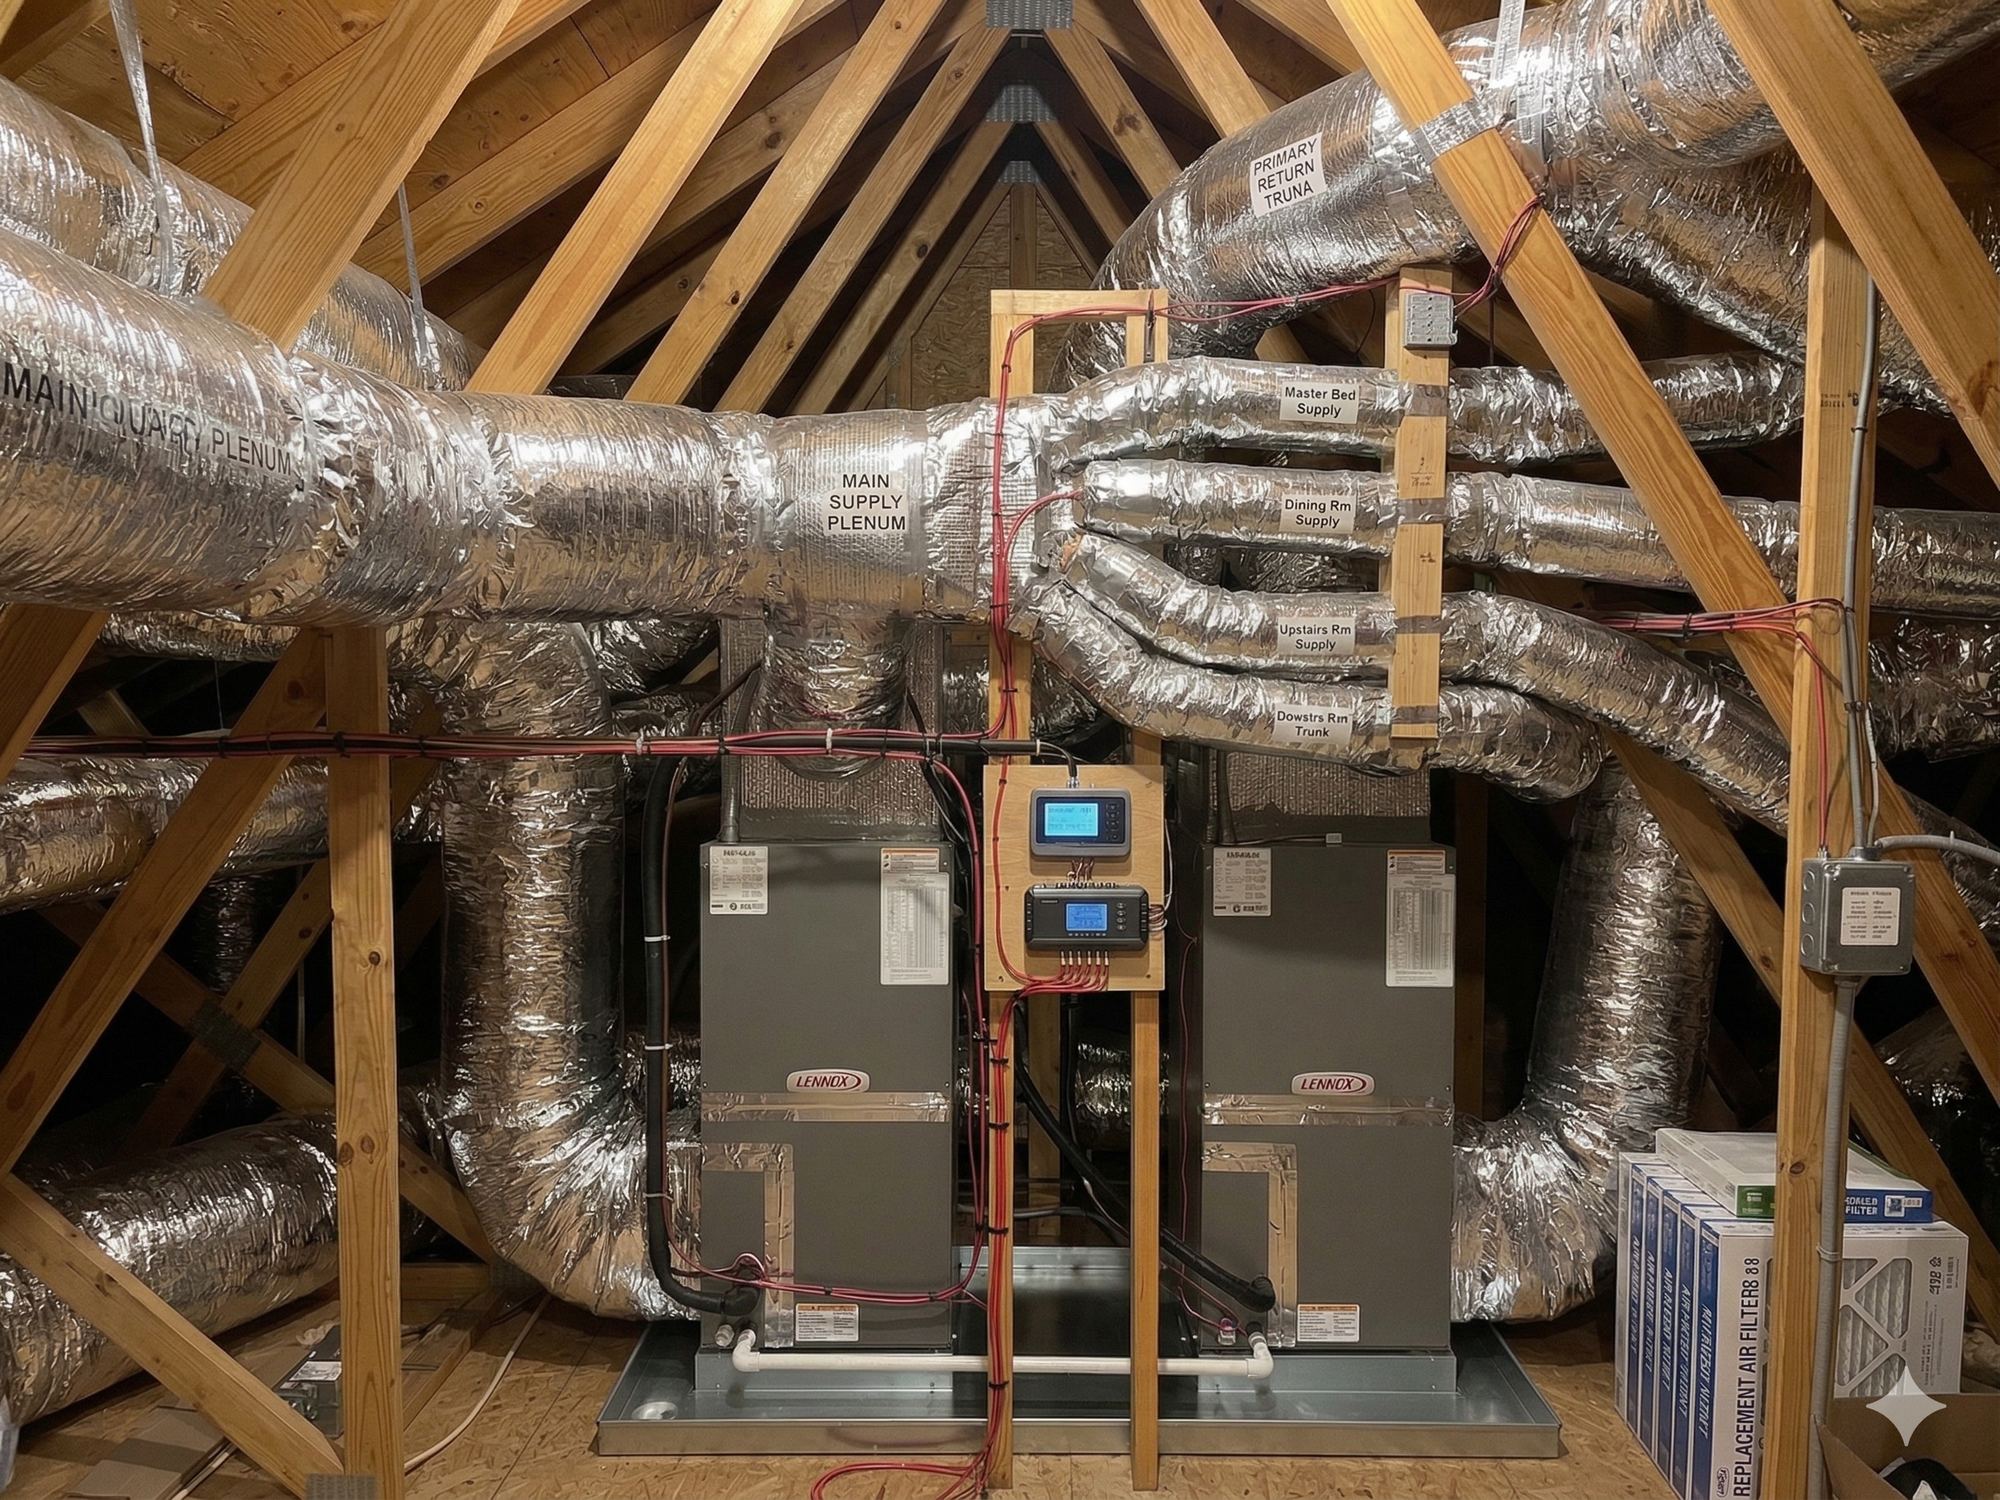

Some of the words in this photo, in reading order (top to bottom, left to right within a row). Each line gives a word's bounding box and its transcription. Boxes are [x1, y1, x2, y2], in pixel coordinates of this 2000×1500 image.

[1254, 138, 1317, 176] PRIMARY
[1258, 159, 1314, 193] RETURN
[1264, 180, 1314, 209] TRUNA
[1285, 387, 1328, 400] Master
[1331, 389, 1356, 401] Bed
[1297, 403, 1341, 418] Supply
[4, 362, 87, 419] MAIN
[211, 427, 292, 476] PLENUM
[842, 474, 889, 488] MAIN
[829, 495, 903, 509] SUPPLY
[1285, 499, 1326, 513] Dining
[1330, 501, 1351, 512] Rm
[828, 516, 905, 530] PLENUM
[1296, 515, 1340, 529] Supply
[1280, 624, 1328, 637] Upstairs
[1331, 624, 1351, 635] Rm
[1295, 639, 1336, 651] Supply
[1277, 711, 1324, 723] Dowstrs
[1327, 713, 1348, 724] Rm
[1295, 726, 1329, 737] Trunk
[796, 1075, 849, 1088] LENNOX
[1301, 1078, 1354, 1090] LENNOX
[1845, 1205, 1878, 1215] FILTER
[1738, 1346, 1757, 1373] AIR
[1733, 1377, 1756, 1496] REPLACEMENT
